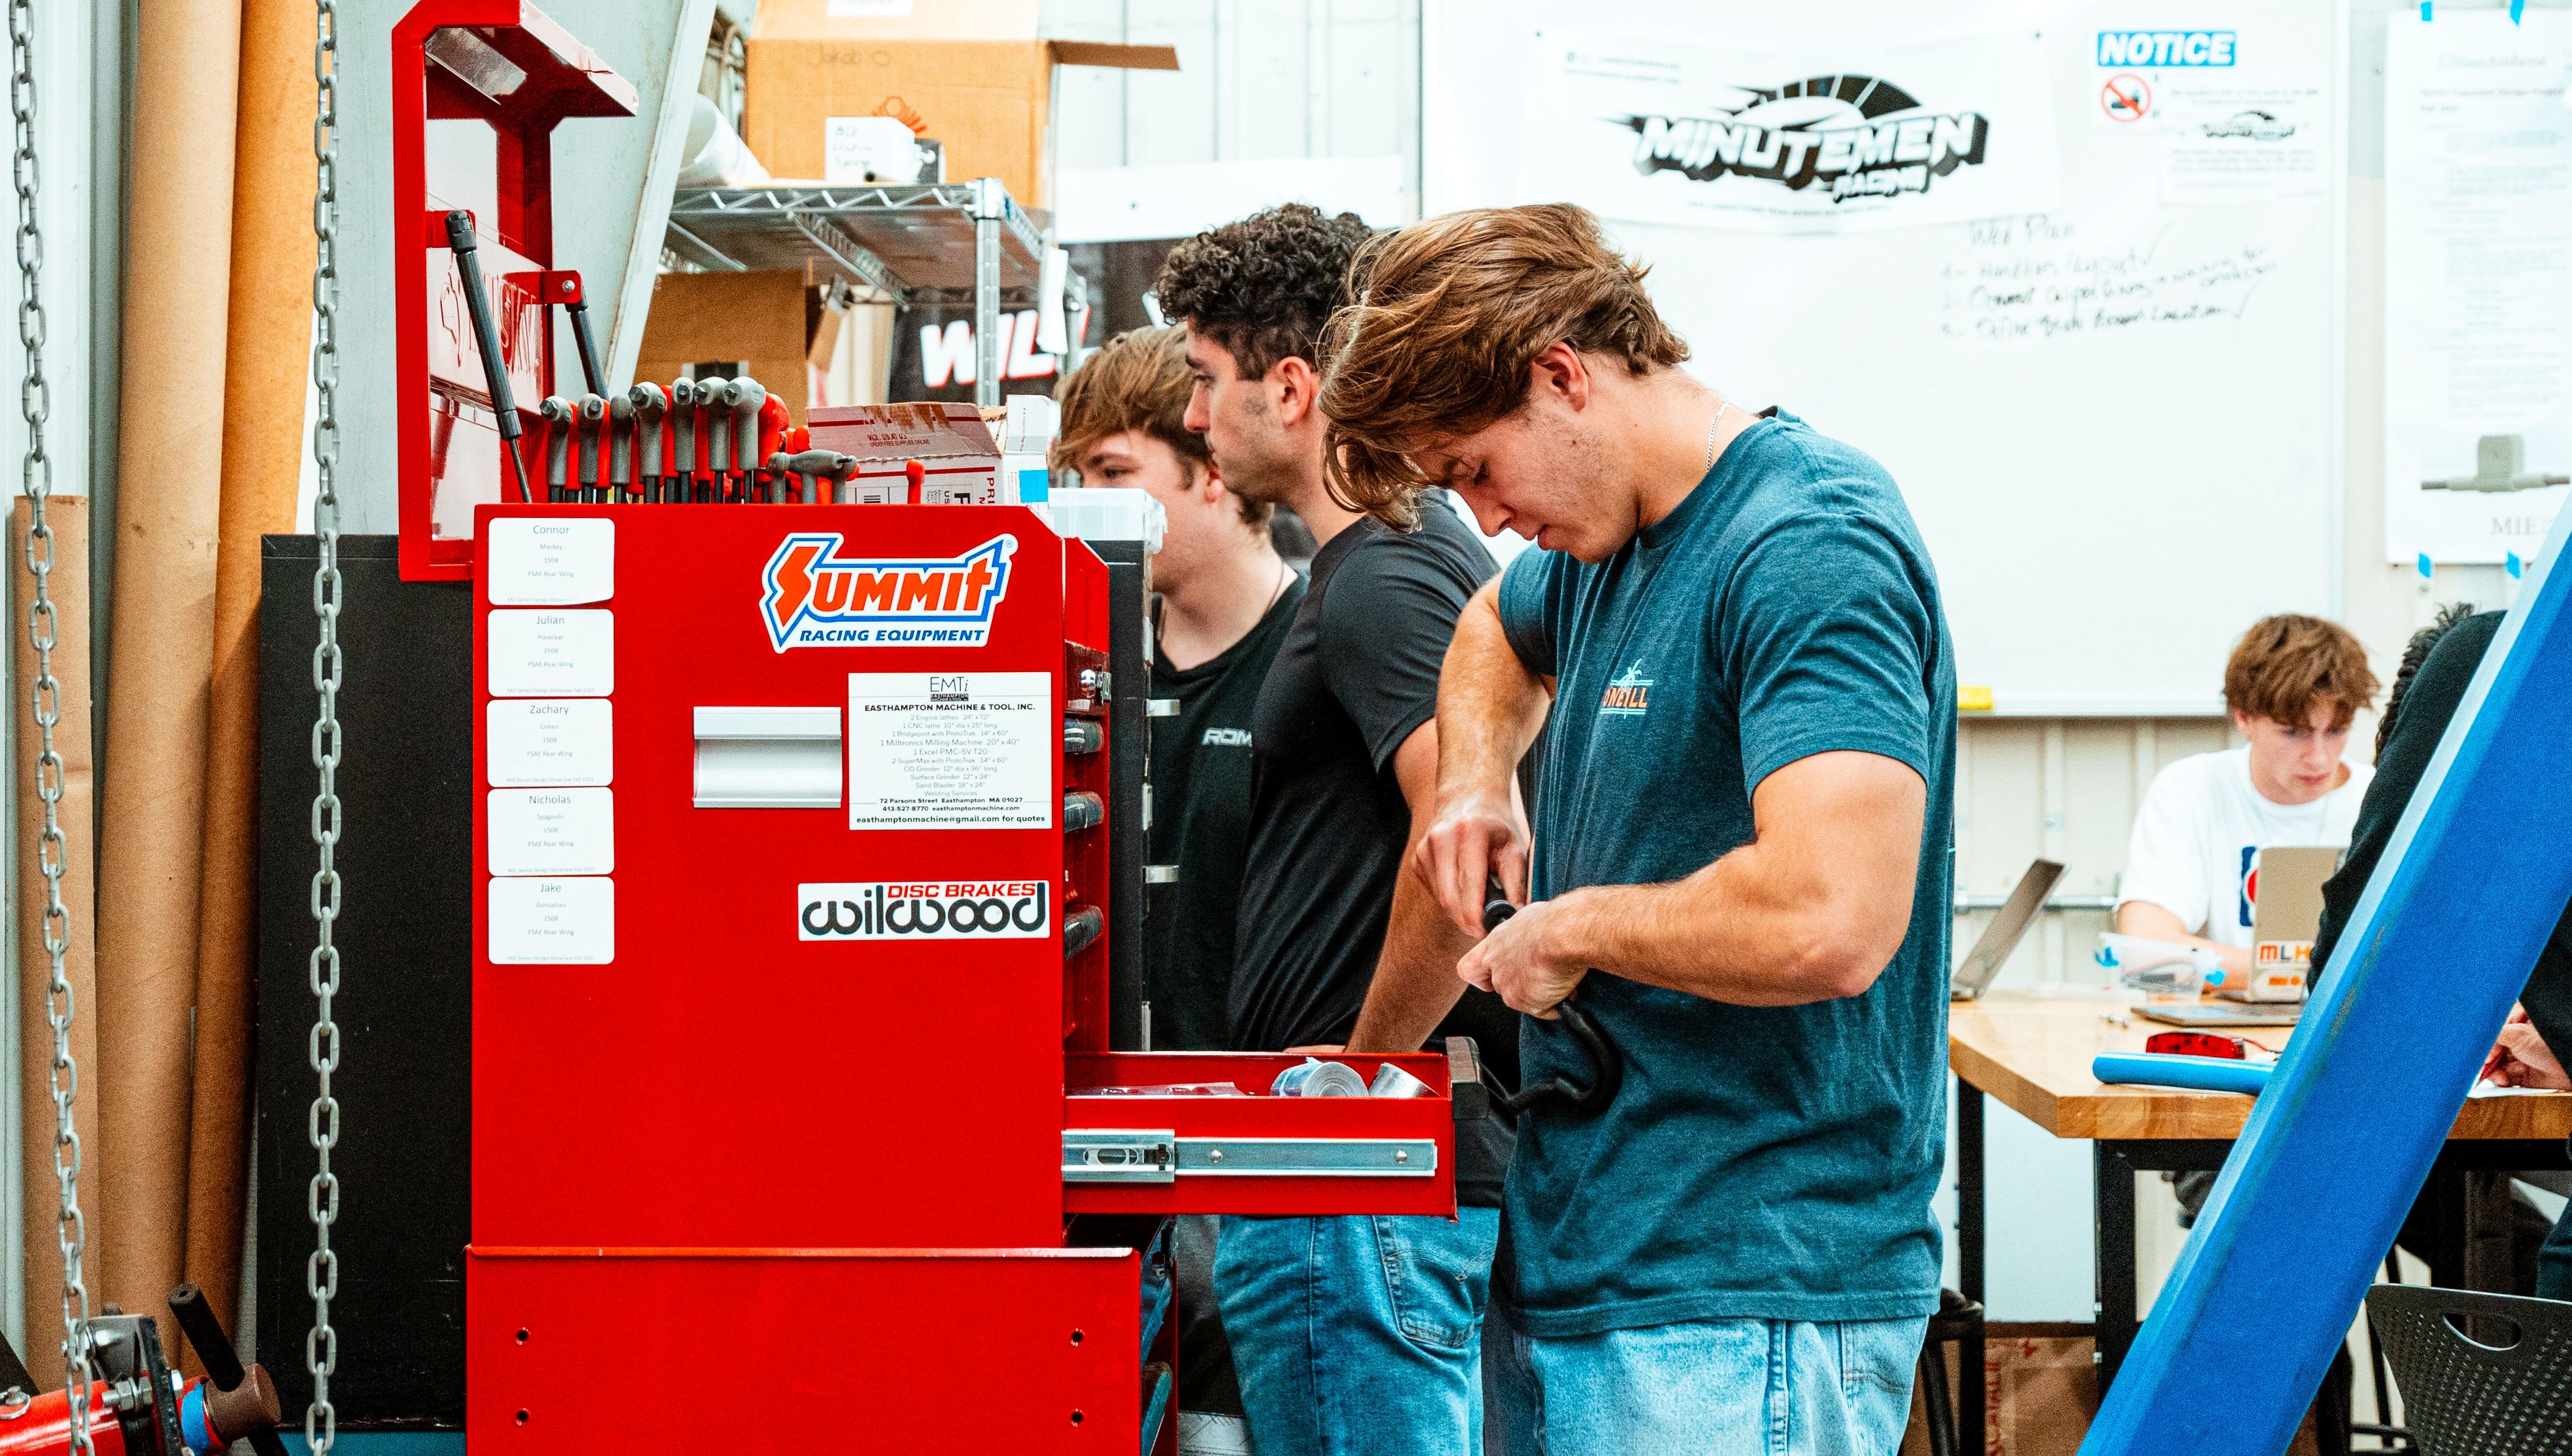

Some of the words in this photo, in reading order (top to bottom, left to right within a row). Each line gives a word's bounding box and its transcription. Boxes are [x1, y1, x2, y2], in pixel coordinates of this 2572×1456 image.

[2099, 33, 2234, 65] NOTICE
[1634, 113, 1987, 184] MINUTEMEN
[533, 525, 569, 534] Connor
[776, 547, 992, 628] SUMMIt
[537, 615, 564, 624] Julian
[800, 630, 869, 641] RACING
[875, 630, 985, 641] EQUIPMENT
[930, 677, 969, 692] EMTi
[531, 705, 568, 715] Zachary
[529, 795, 571, 804] Nicholas
[857, 815, 999, 824] easthamptonmachine@gmail.com
[541, 884, 561, 892] Jake
[888, 885, 940, 898] DISC
[945, 883, 1036, 898] BRAKES
[802, 882, 1045, 936] wilwood
